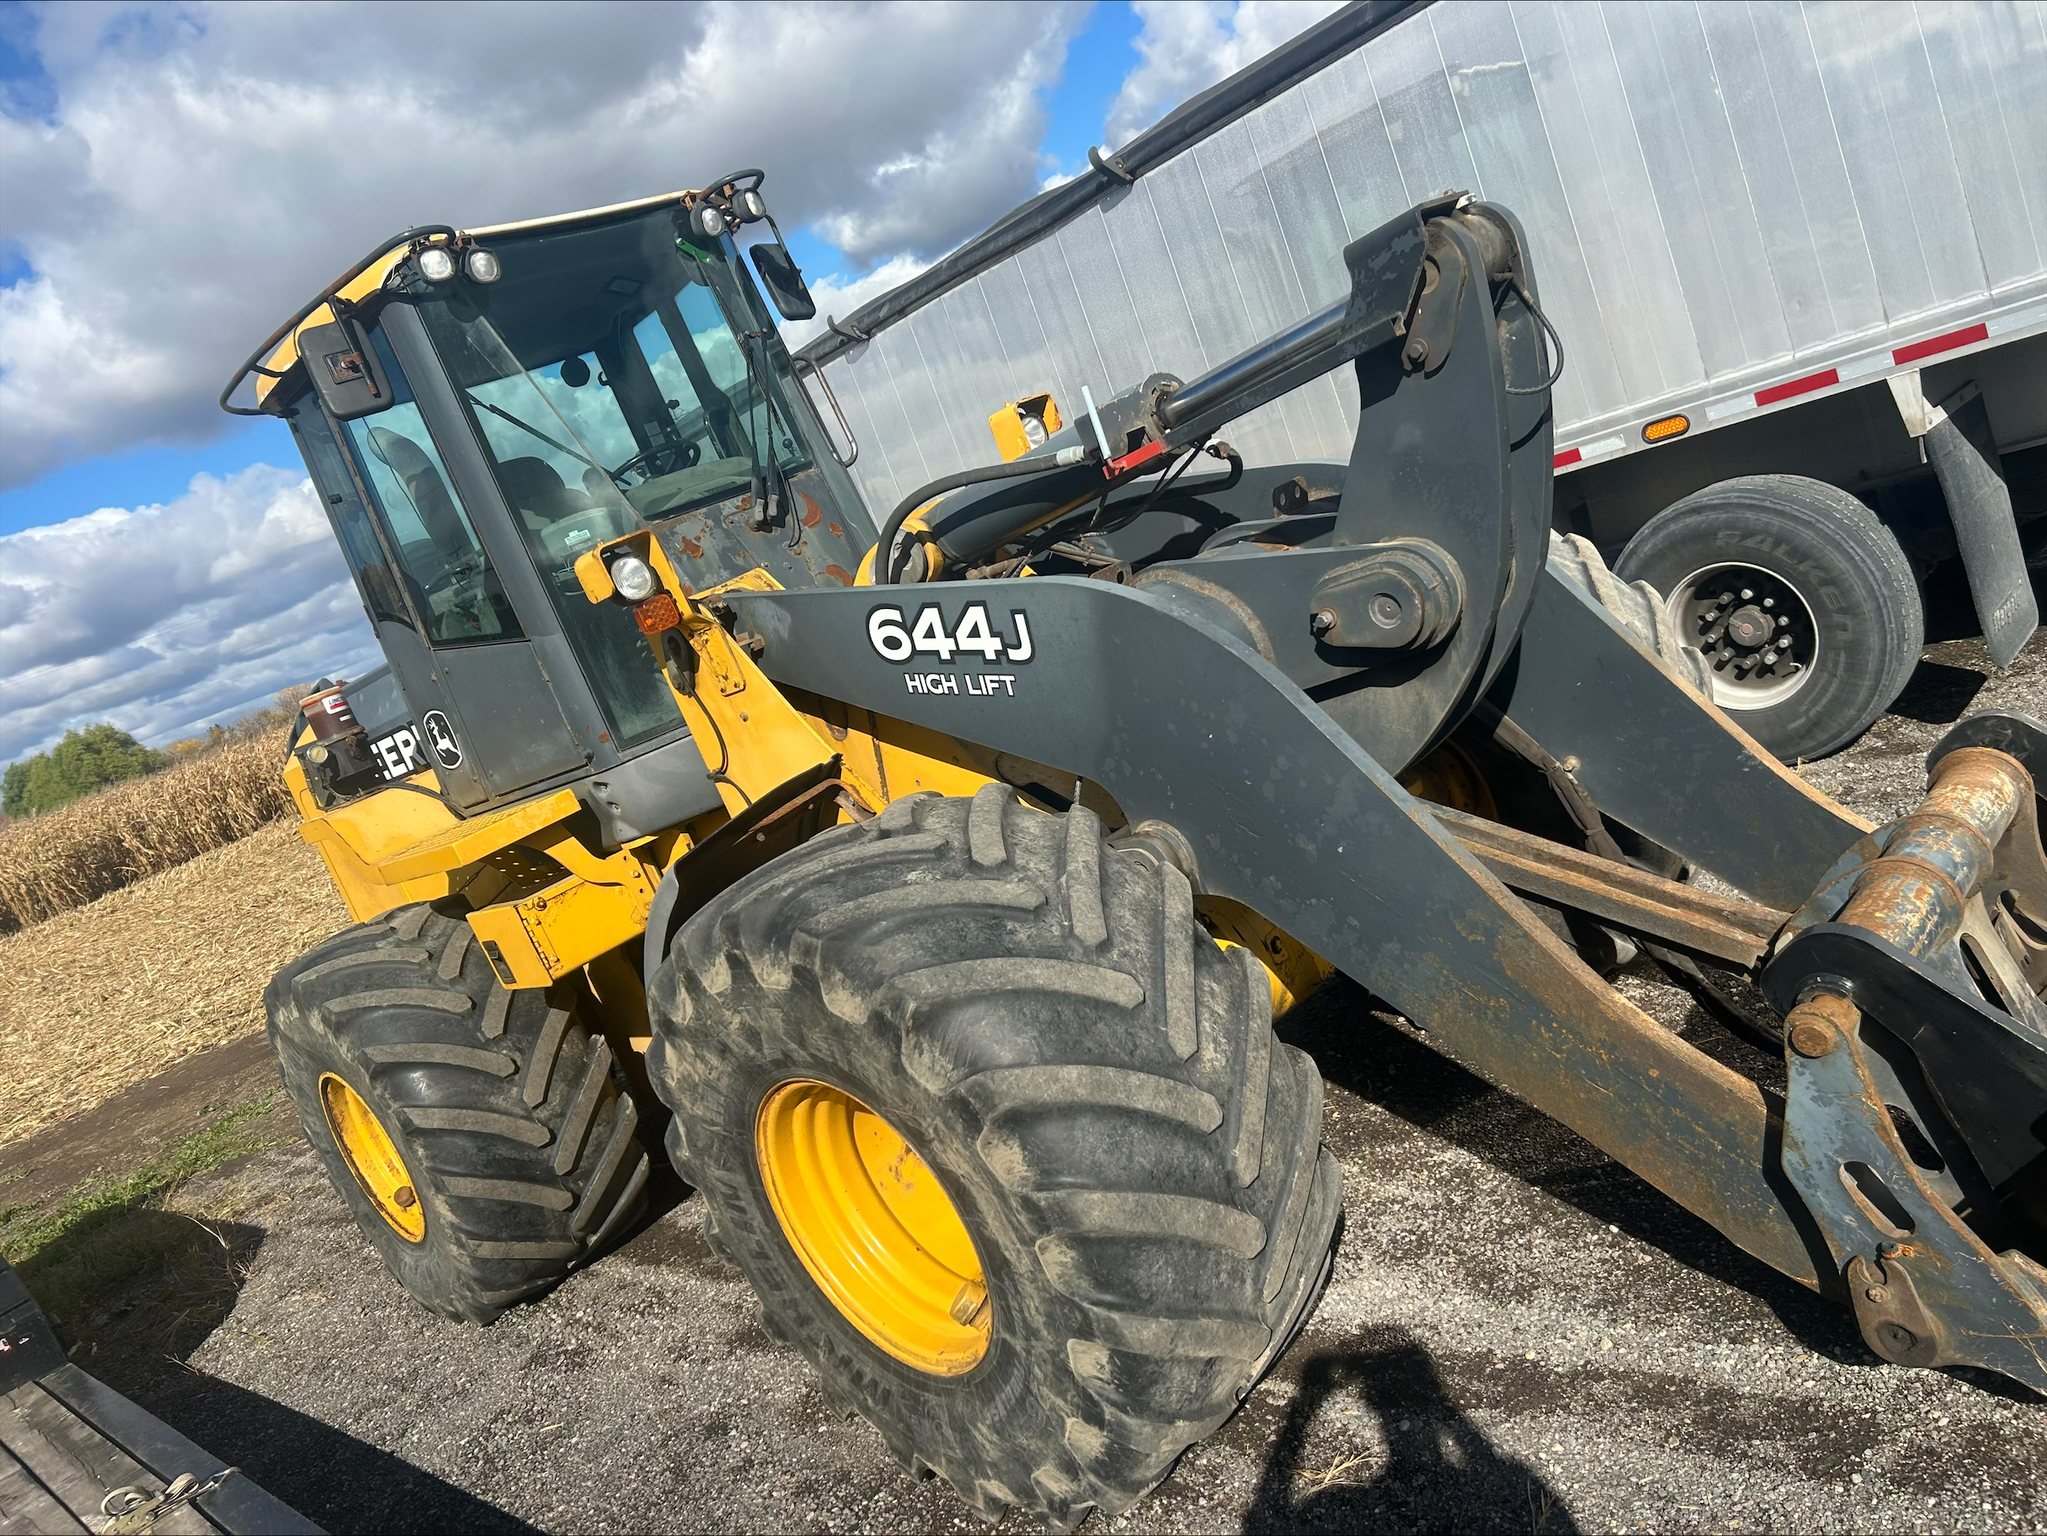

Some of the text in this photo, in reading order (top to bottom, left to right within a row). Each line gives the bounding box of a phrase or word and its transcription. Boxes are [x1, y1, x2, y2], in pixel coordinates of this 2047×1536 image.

[868, 605, 1033, 662] 644J
[904, 672, 1017, 698] HIGH LIFT
